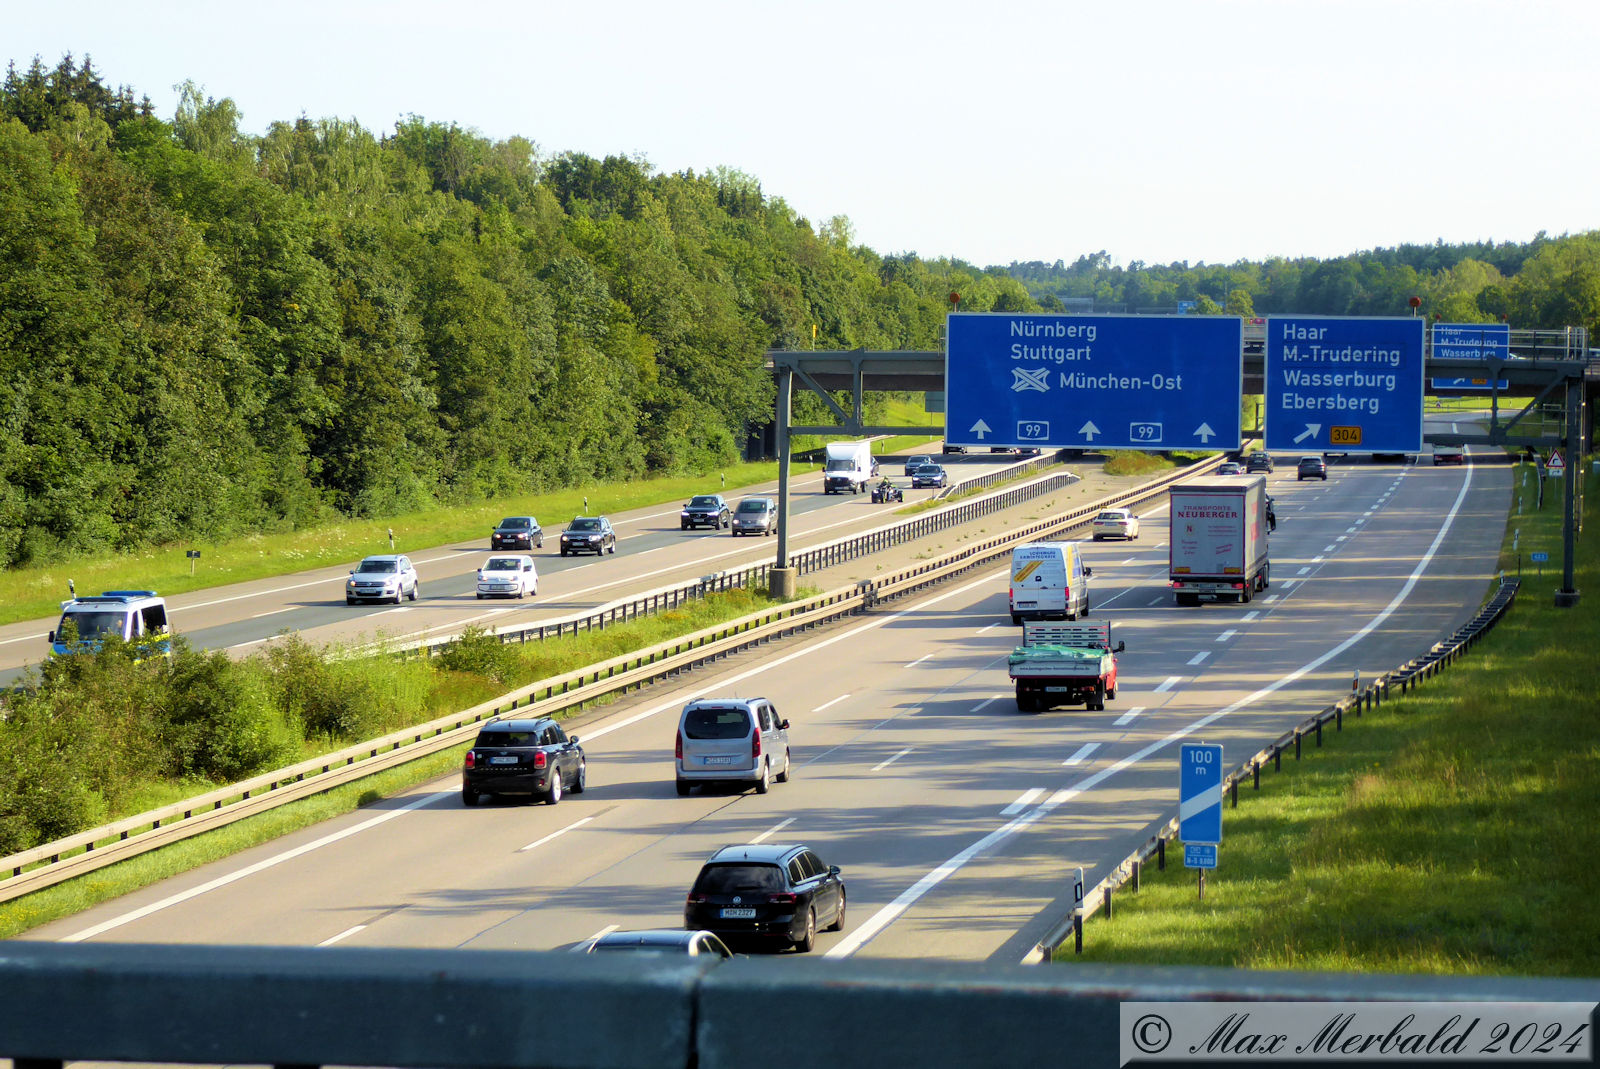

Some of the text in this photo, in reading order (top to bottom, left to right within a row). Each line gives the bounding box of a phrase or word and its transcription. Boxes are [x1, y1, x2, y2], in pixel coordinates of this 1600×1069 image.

[1010, 321, 1097, 342] Nürnberg
[1283, 323, 1328, 340] Haar
[1010, 344, 1091, 364] Stuttgart
[1282, 345, 1401, 367] M.-Trudering
[1060, 372, 1182, 391] München-Ost
[1283, 370, 1396, 391] Wasserburg
[1282, 393, 1380, 414] Ebersberg
[1025, 425, 1041, 438] 99
[1138, 426, 1154, 439] 99
[1333, 429, 1358, 442] 304
[1190, 750, 1213, 764] 100
[1195, 767, 1207, 775] m
